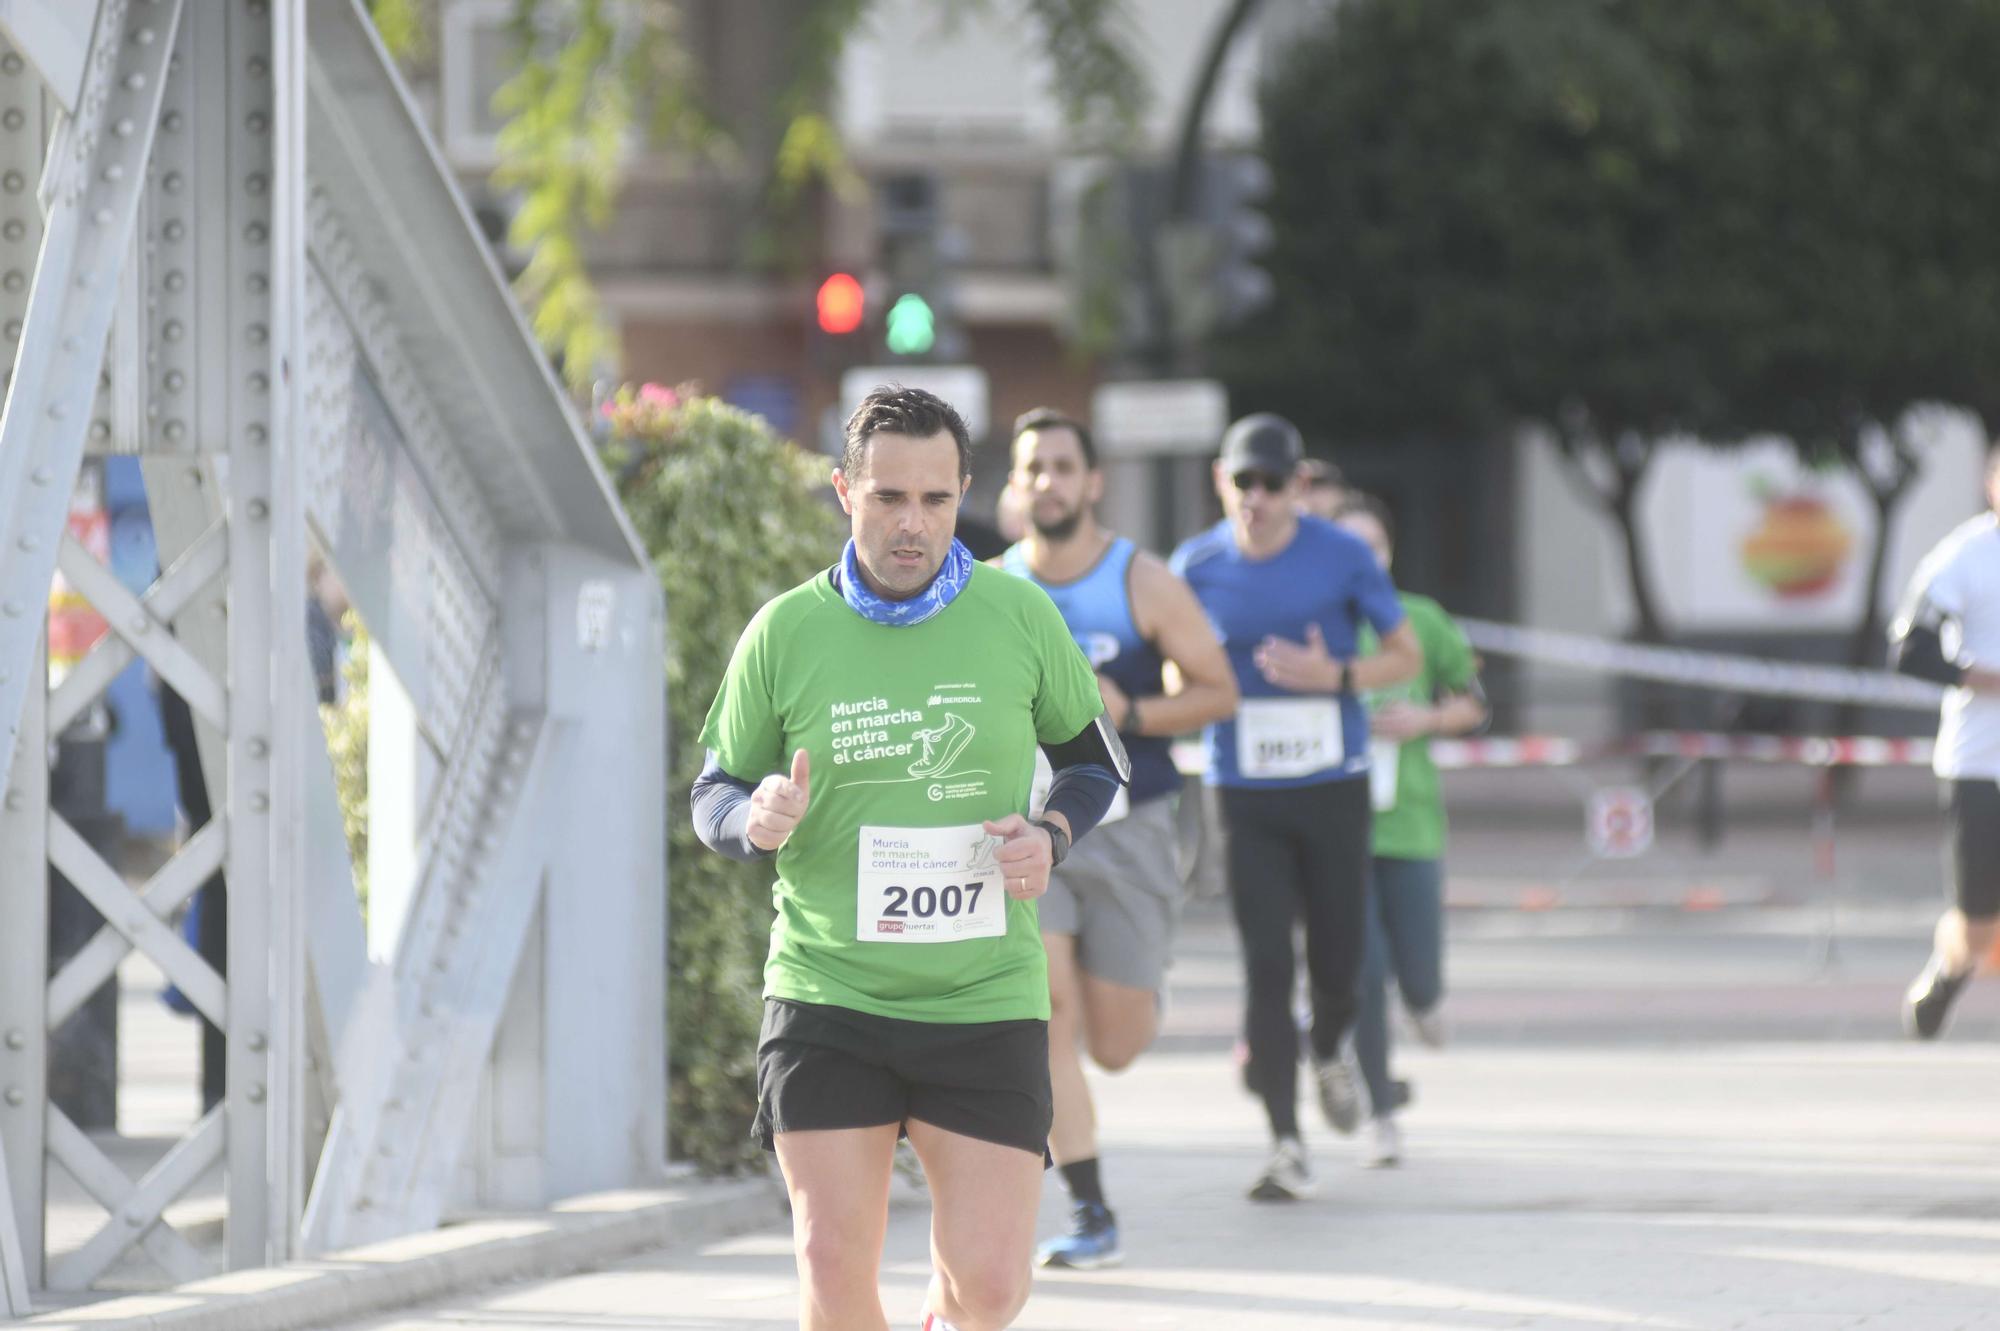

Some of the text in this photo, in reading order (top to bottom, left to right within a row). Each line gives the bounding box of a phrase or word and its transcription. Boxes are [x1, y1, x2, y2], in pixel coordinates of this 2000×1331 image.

[831, 697, 888, 718] Murcia
[942, 696, 982, 704] IBERDROLA
[831, 709, 923, 733] en marcha
[831, 730, 889, 749] contra
[833, 745, 914, 765] el cáncer
[872, 838, 909, 849] Murcia
[872, 849, 930, 859] en marcha
[871, 860, 958, 869] contra el cáncer
[882, 881, 983, 918] 2007
